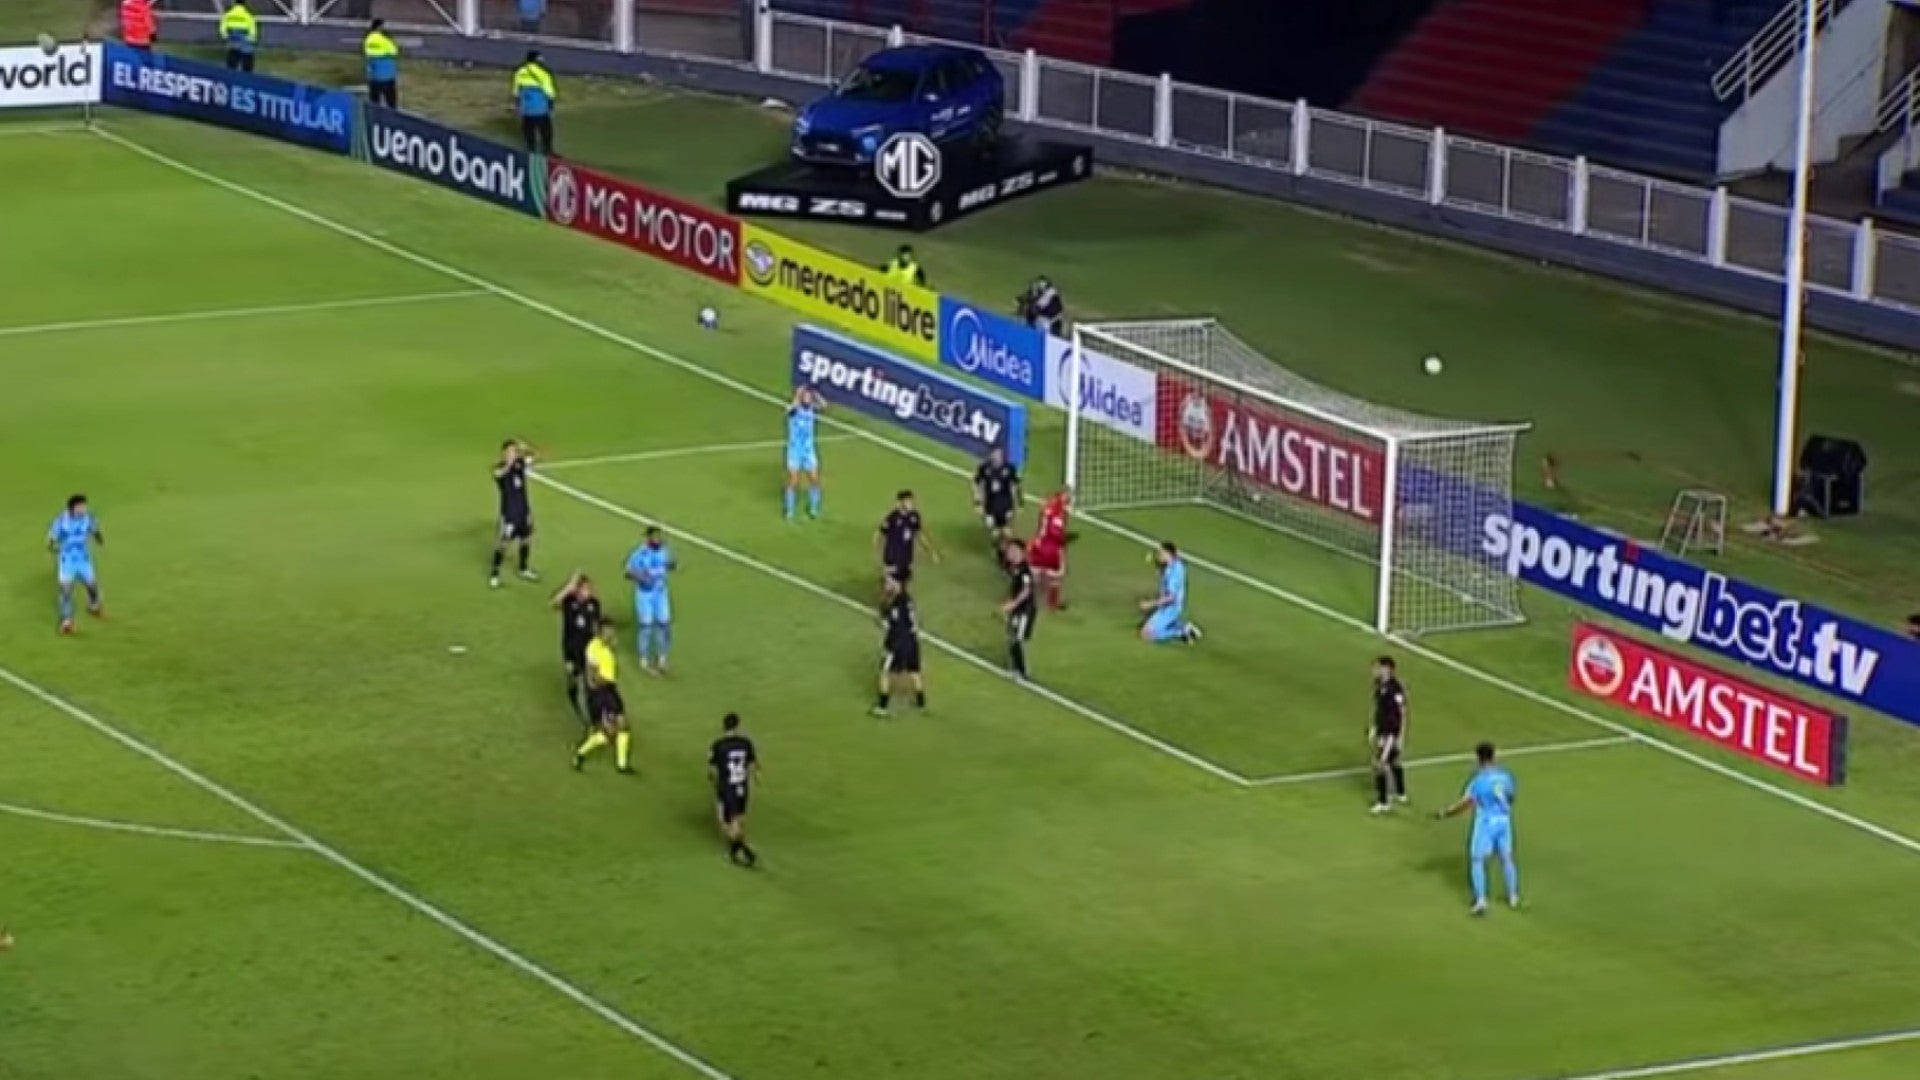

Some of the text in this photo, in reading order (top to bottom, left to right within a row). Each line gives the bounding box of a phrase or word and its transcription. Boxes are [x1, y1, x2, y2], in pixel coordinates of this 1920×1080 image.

[113, 62, 136, 89] EL
[231, 85, 256, 114] ES
[258, 92, 345, 136] TITULAR
[374, 124, 524, 200] ueno bank
[739, 192, 799, 213] MG
[879, 137, 939, 195] MG
[585, 183, 735, 274] MG MOTOR
[780, 257, 935, 341] mercado libre
[951, 310, 1033, 386] Midea
[1060, 348, 1142, 426] Midea
[798, 350, 1001, 443] sportingbet.tv
[1219, 411, 1372, 518] AMSTEL
[1482, 513, 1879, 695] sportingbet.tv
[1629, 658, 1820, 774] AMSTEL
